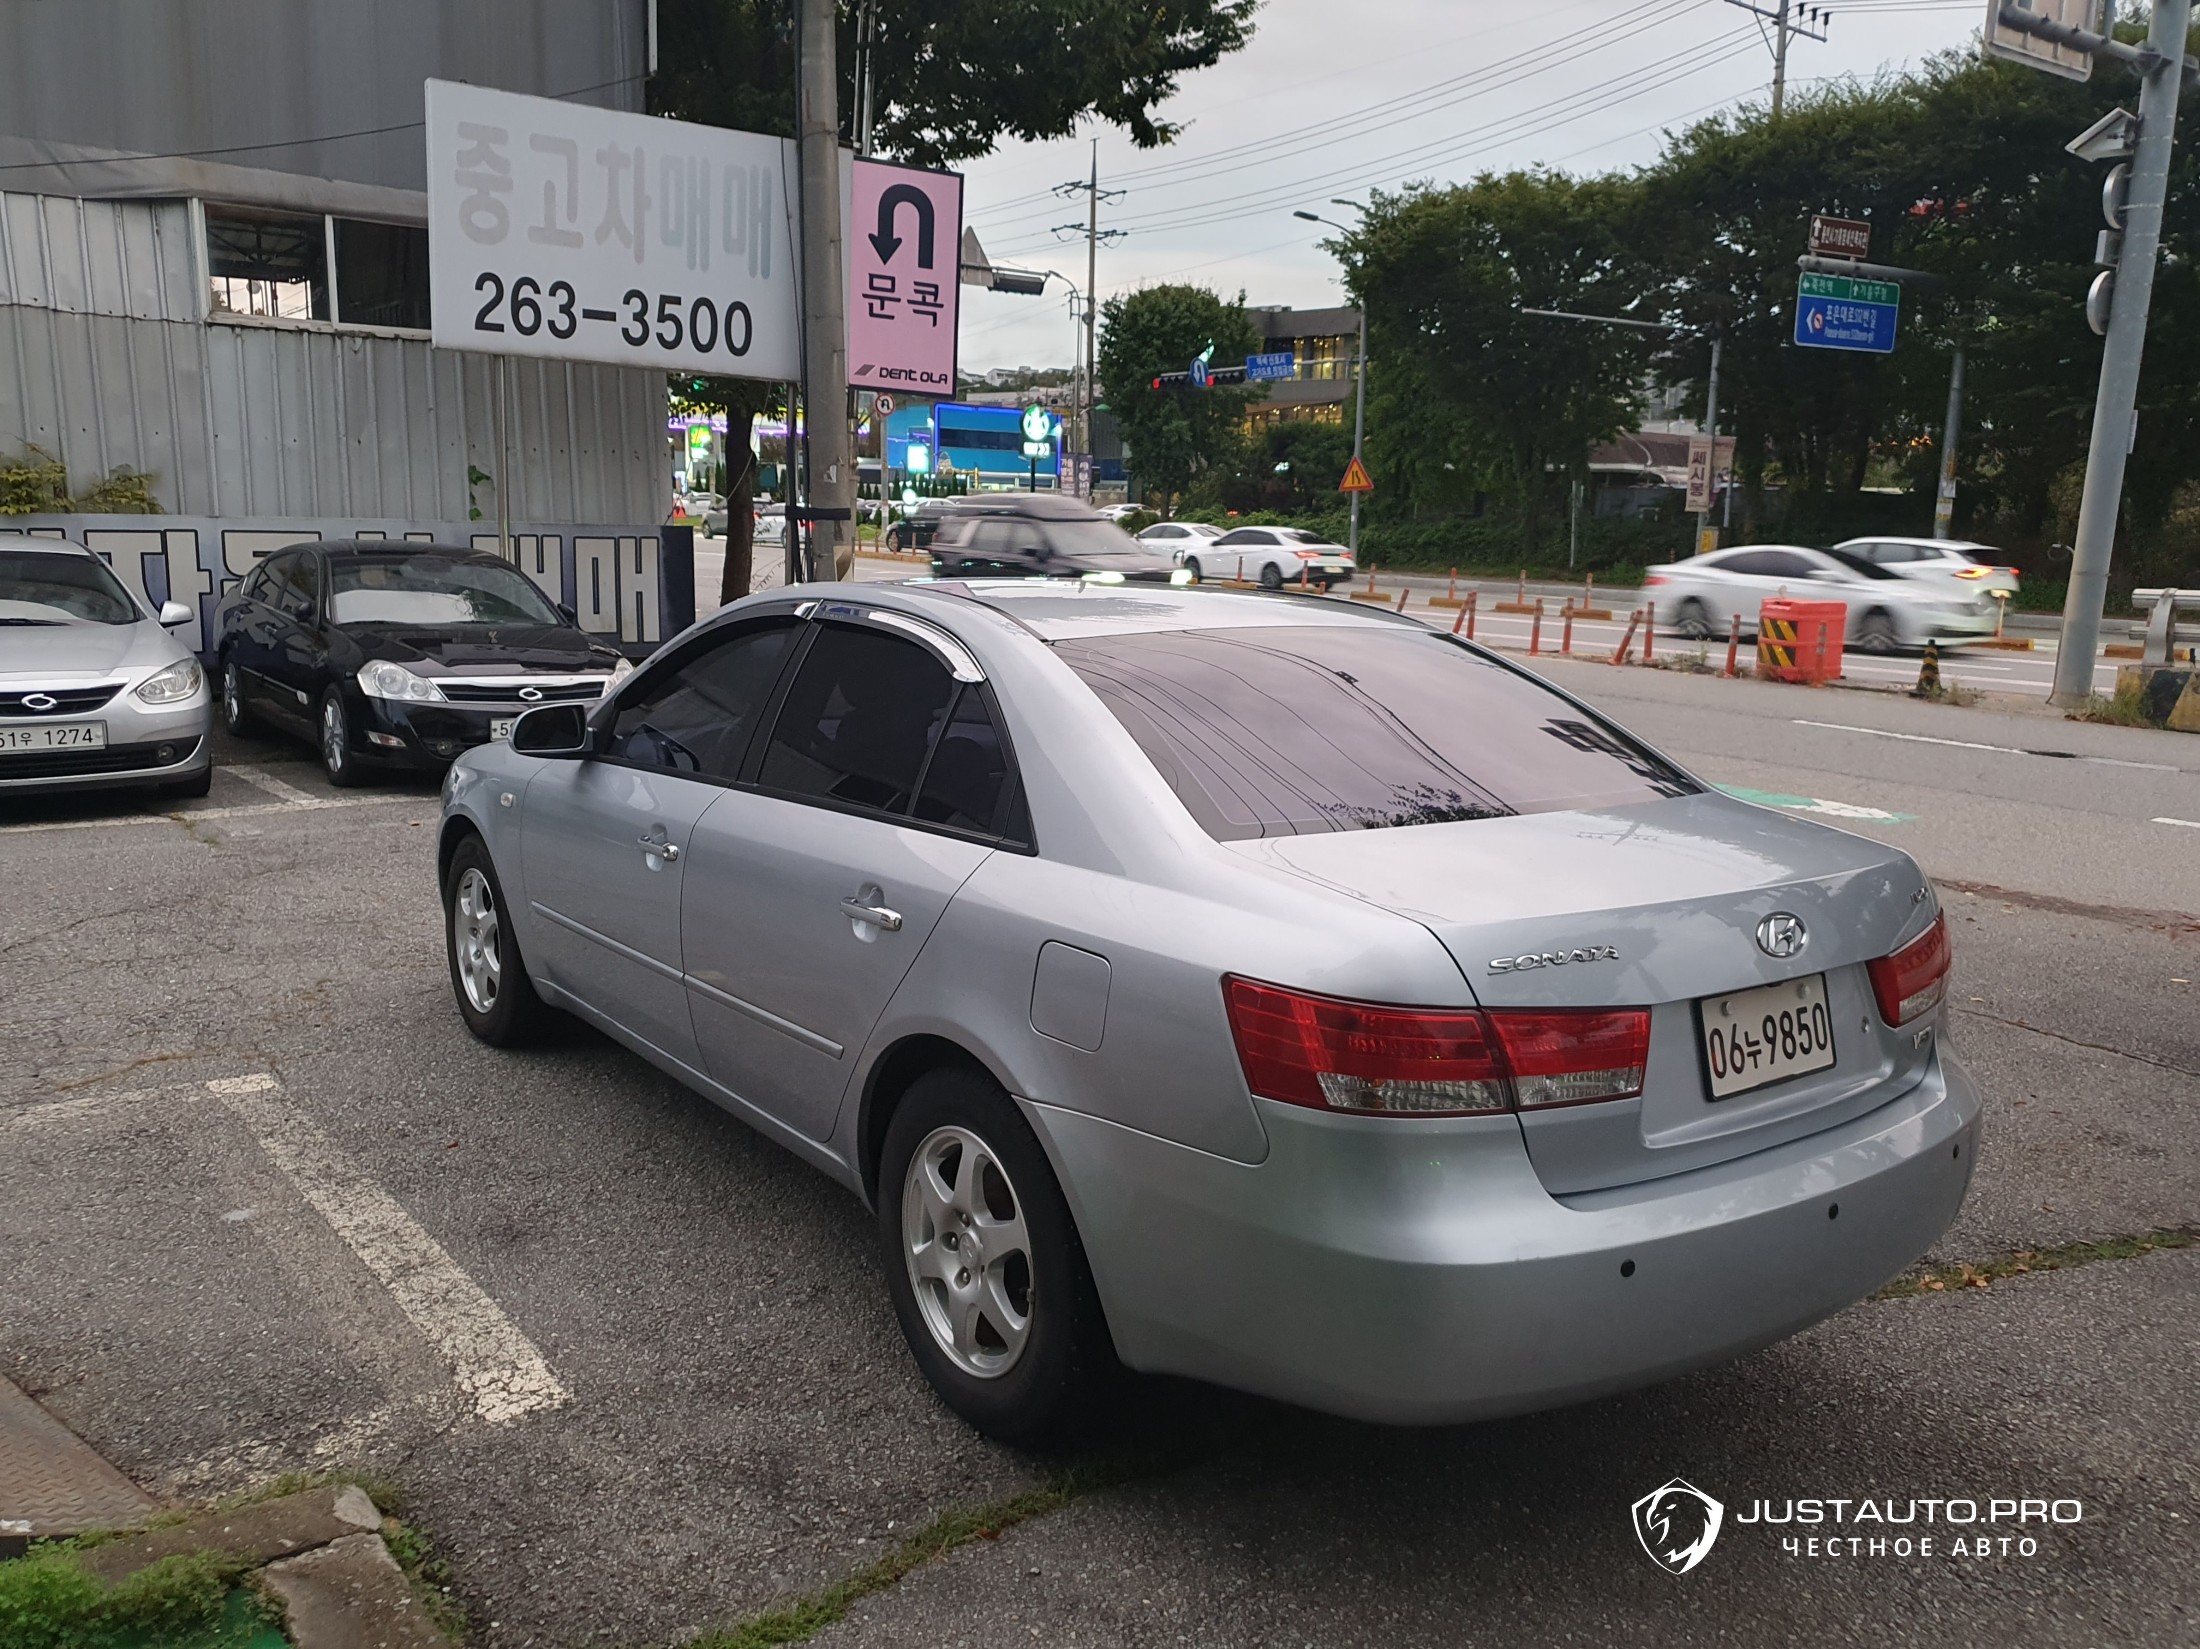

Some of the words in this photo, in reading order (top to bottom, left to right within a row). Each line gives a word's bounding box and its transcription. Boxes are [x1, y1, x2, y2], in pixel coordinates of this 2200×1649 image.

[454, 121, 772, 280] 중고차매매
[474, 272, 753, 357] 263-3500
[862, 272, 944, 328] 문콕
[920, 371, 948, 384] OLA
[44, 728, 93, 745] 1274
[1487, 945, 1620, 976] SONATA
[1709, 1002, 1828, 1079] 06누9850
